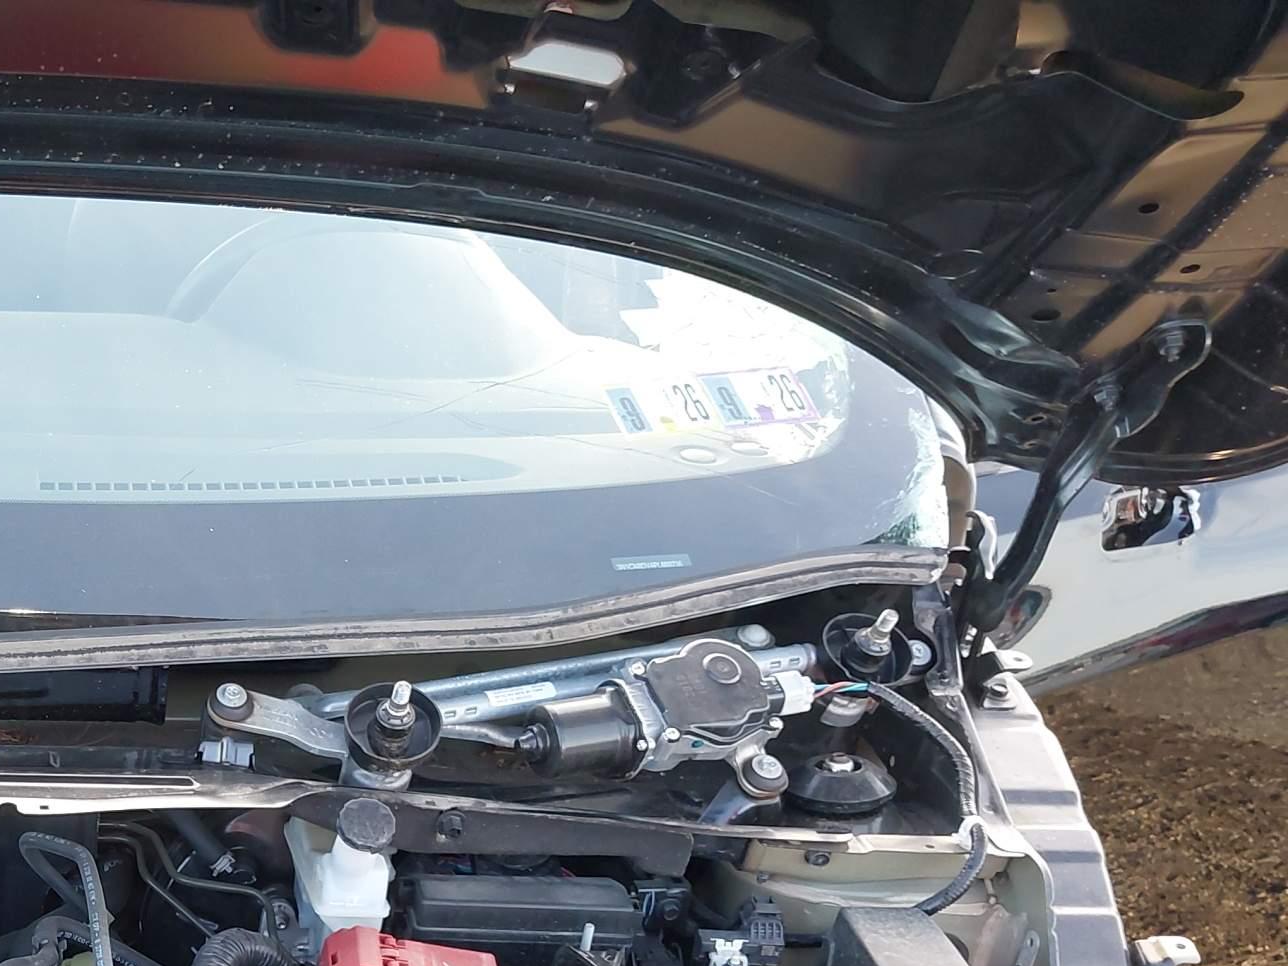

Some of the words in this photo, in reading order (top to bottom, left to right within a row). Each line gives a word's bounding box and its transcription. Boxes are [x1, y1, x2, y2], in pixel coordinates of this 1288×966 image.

[673, 383, 710, 422] 26
[717, 386, 743, 421] 9
[769, 374, 805, 411] 26
